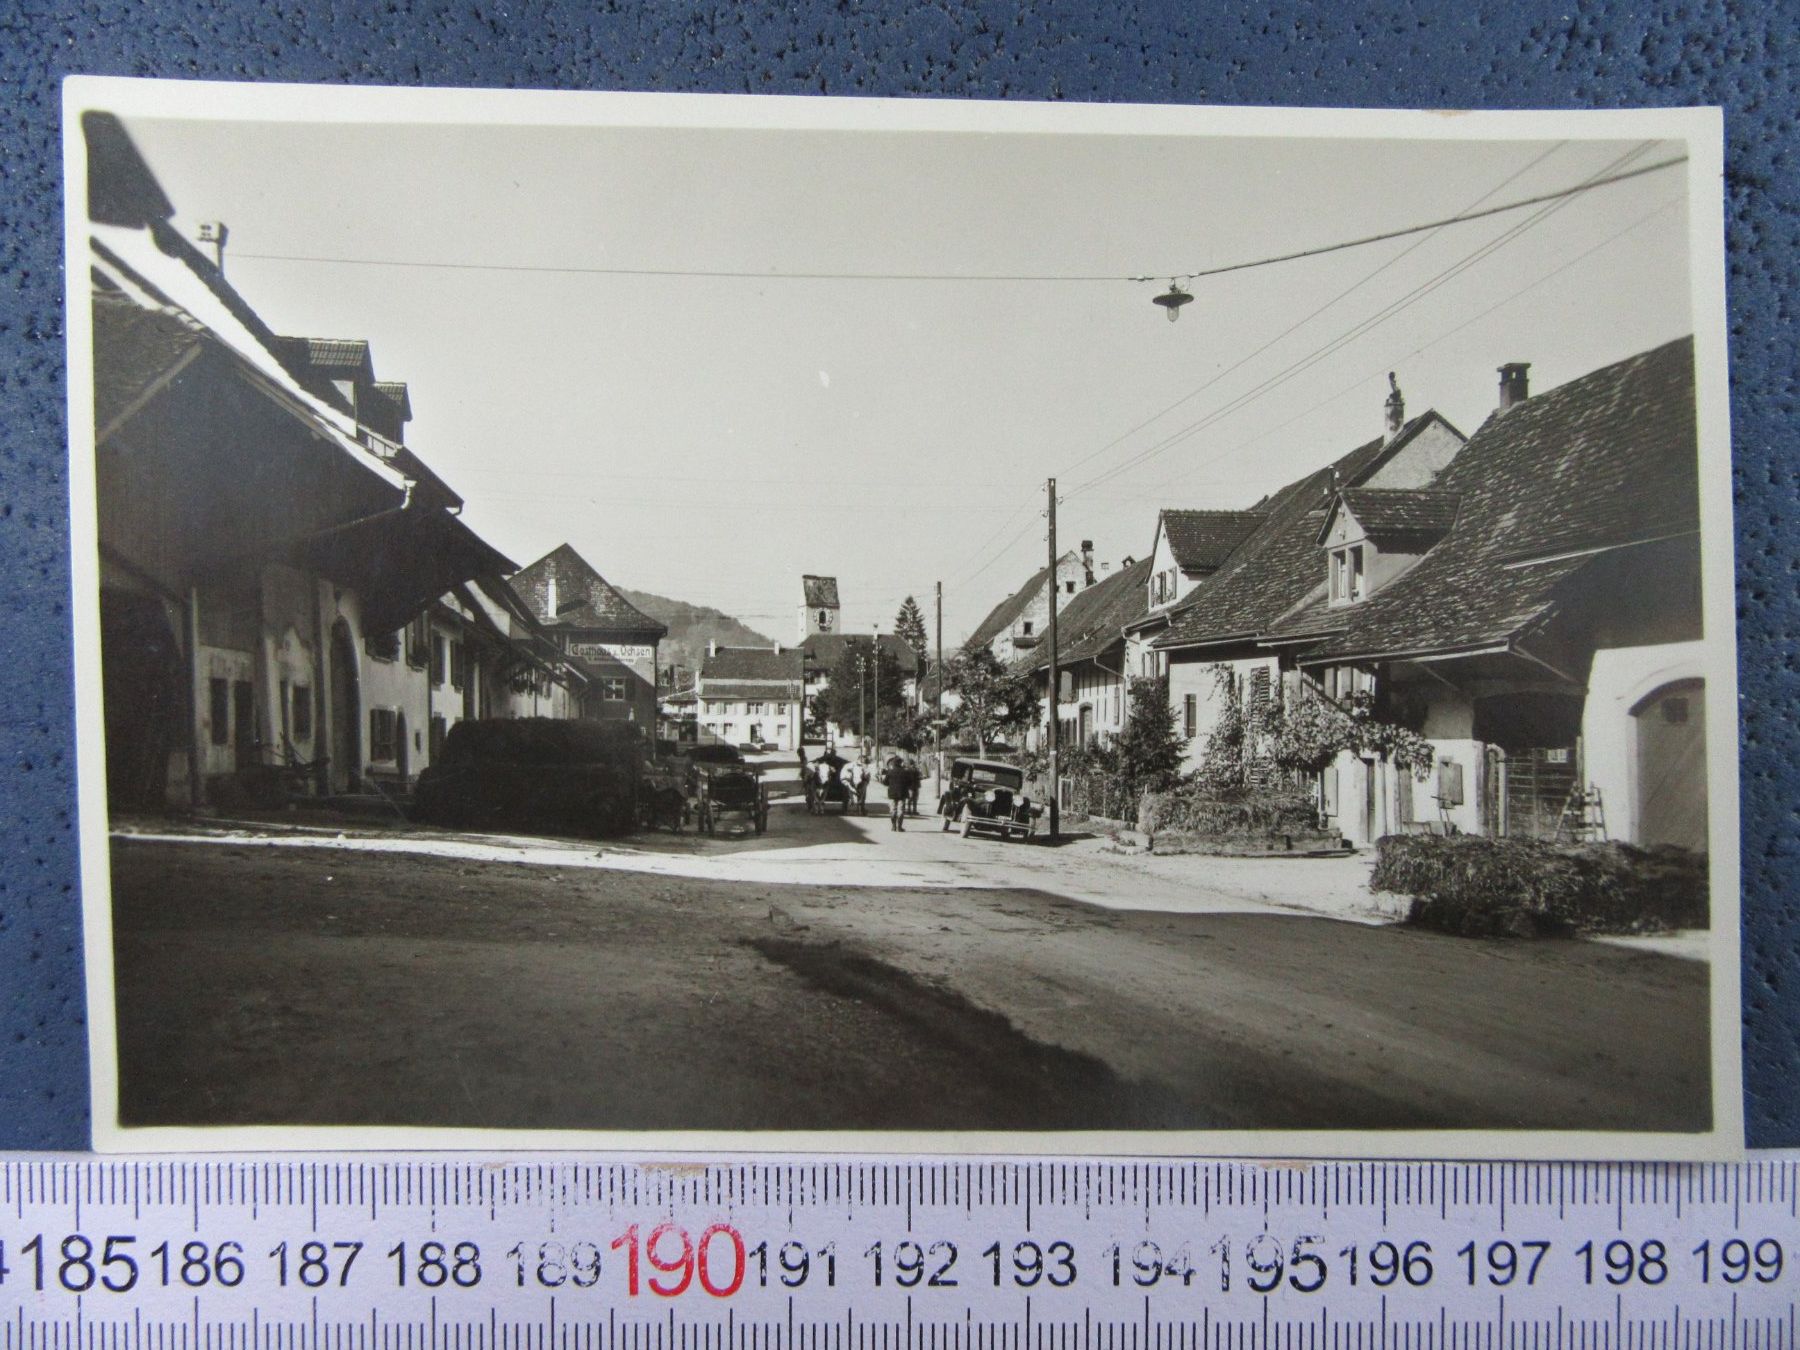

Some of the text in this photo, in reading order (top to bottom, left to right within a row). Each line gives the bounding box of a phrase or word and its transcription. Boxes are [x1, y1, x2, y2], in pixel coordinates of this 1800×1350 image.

[20, 1234, 139, 1293] 185
[150, 1241, 245, 1287] 186
[269, 1241, 364, 1287] 187
[387, 1241, 482, 1288] 188
[506, 1241, 602, 1288] 189
[610, 1222, 747, 1298] 190
[748, 1240, 836, 1288] 191
[863, 1240, 959, 1287] 192
[982, 1240, 1078, 1287] 193
[1102, 1240, 1196, 1287] 194
[1207, 1233, 1328, 1293] 195
[1338, 1240, 1434, 1287] 196
[1457, 1240, 1552, 1287] 197
[1575, 1239, 1669, 1286] 198
[1692, 1238, 1784, 1284] 199
